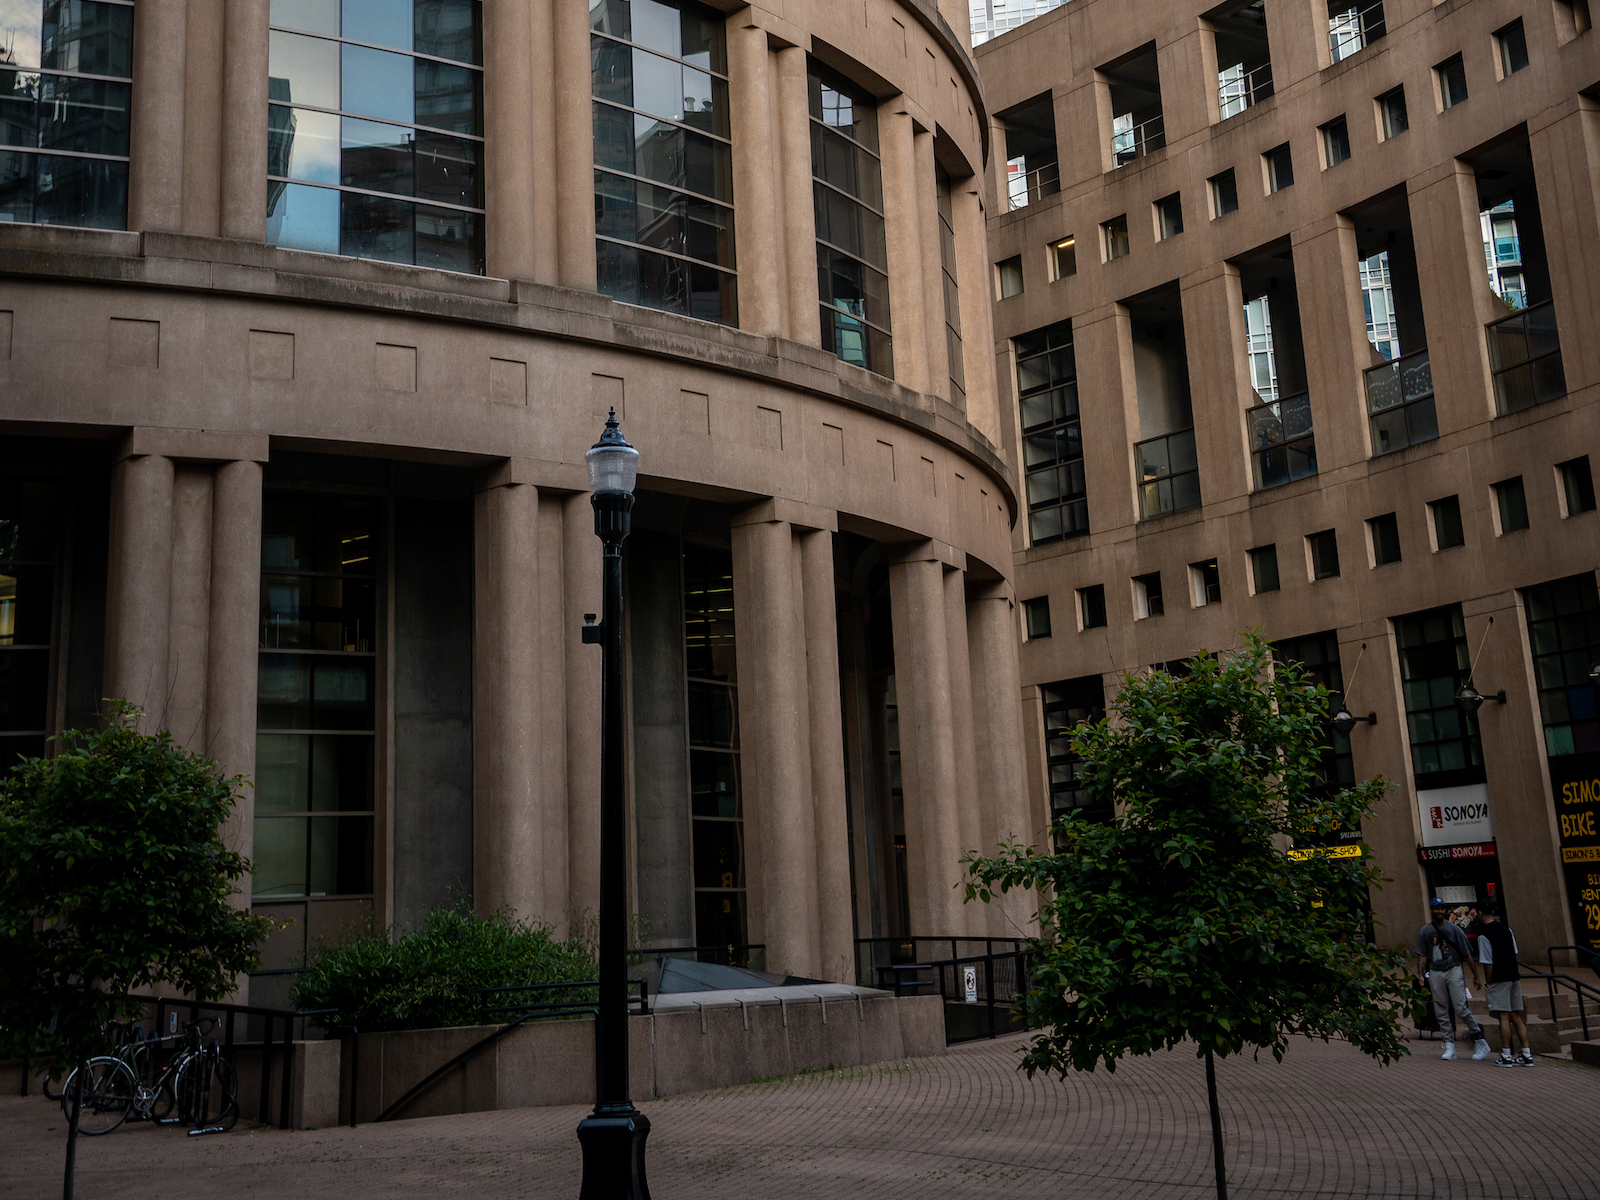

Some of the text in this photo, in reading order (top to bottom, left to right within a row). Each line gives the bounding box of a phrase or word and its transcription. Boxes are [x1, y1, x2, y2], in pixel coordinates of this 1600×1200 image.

[1444, 803, 1488, 821] SONOYA
[1560, 810, 1597, 838] BIKE
[1340, 845, 1357, 856] SHOP
[1427, 848, 1451, 860] SUSHI
[1452, 845, 1483, 858] SONOYA
[1565, 849, 1594, 859] SIMON'S
[1587, 873, 1600, 886] BI
[1585, 903, 1600, 931] 29
